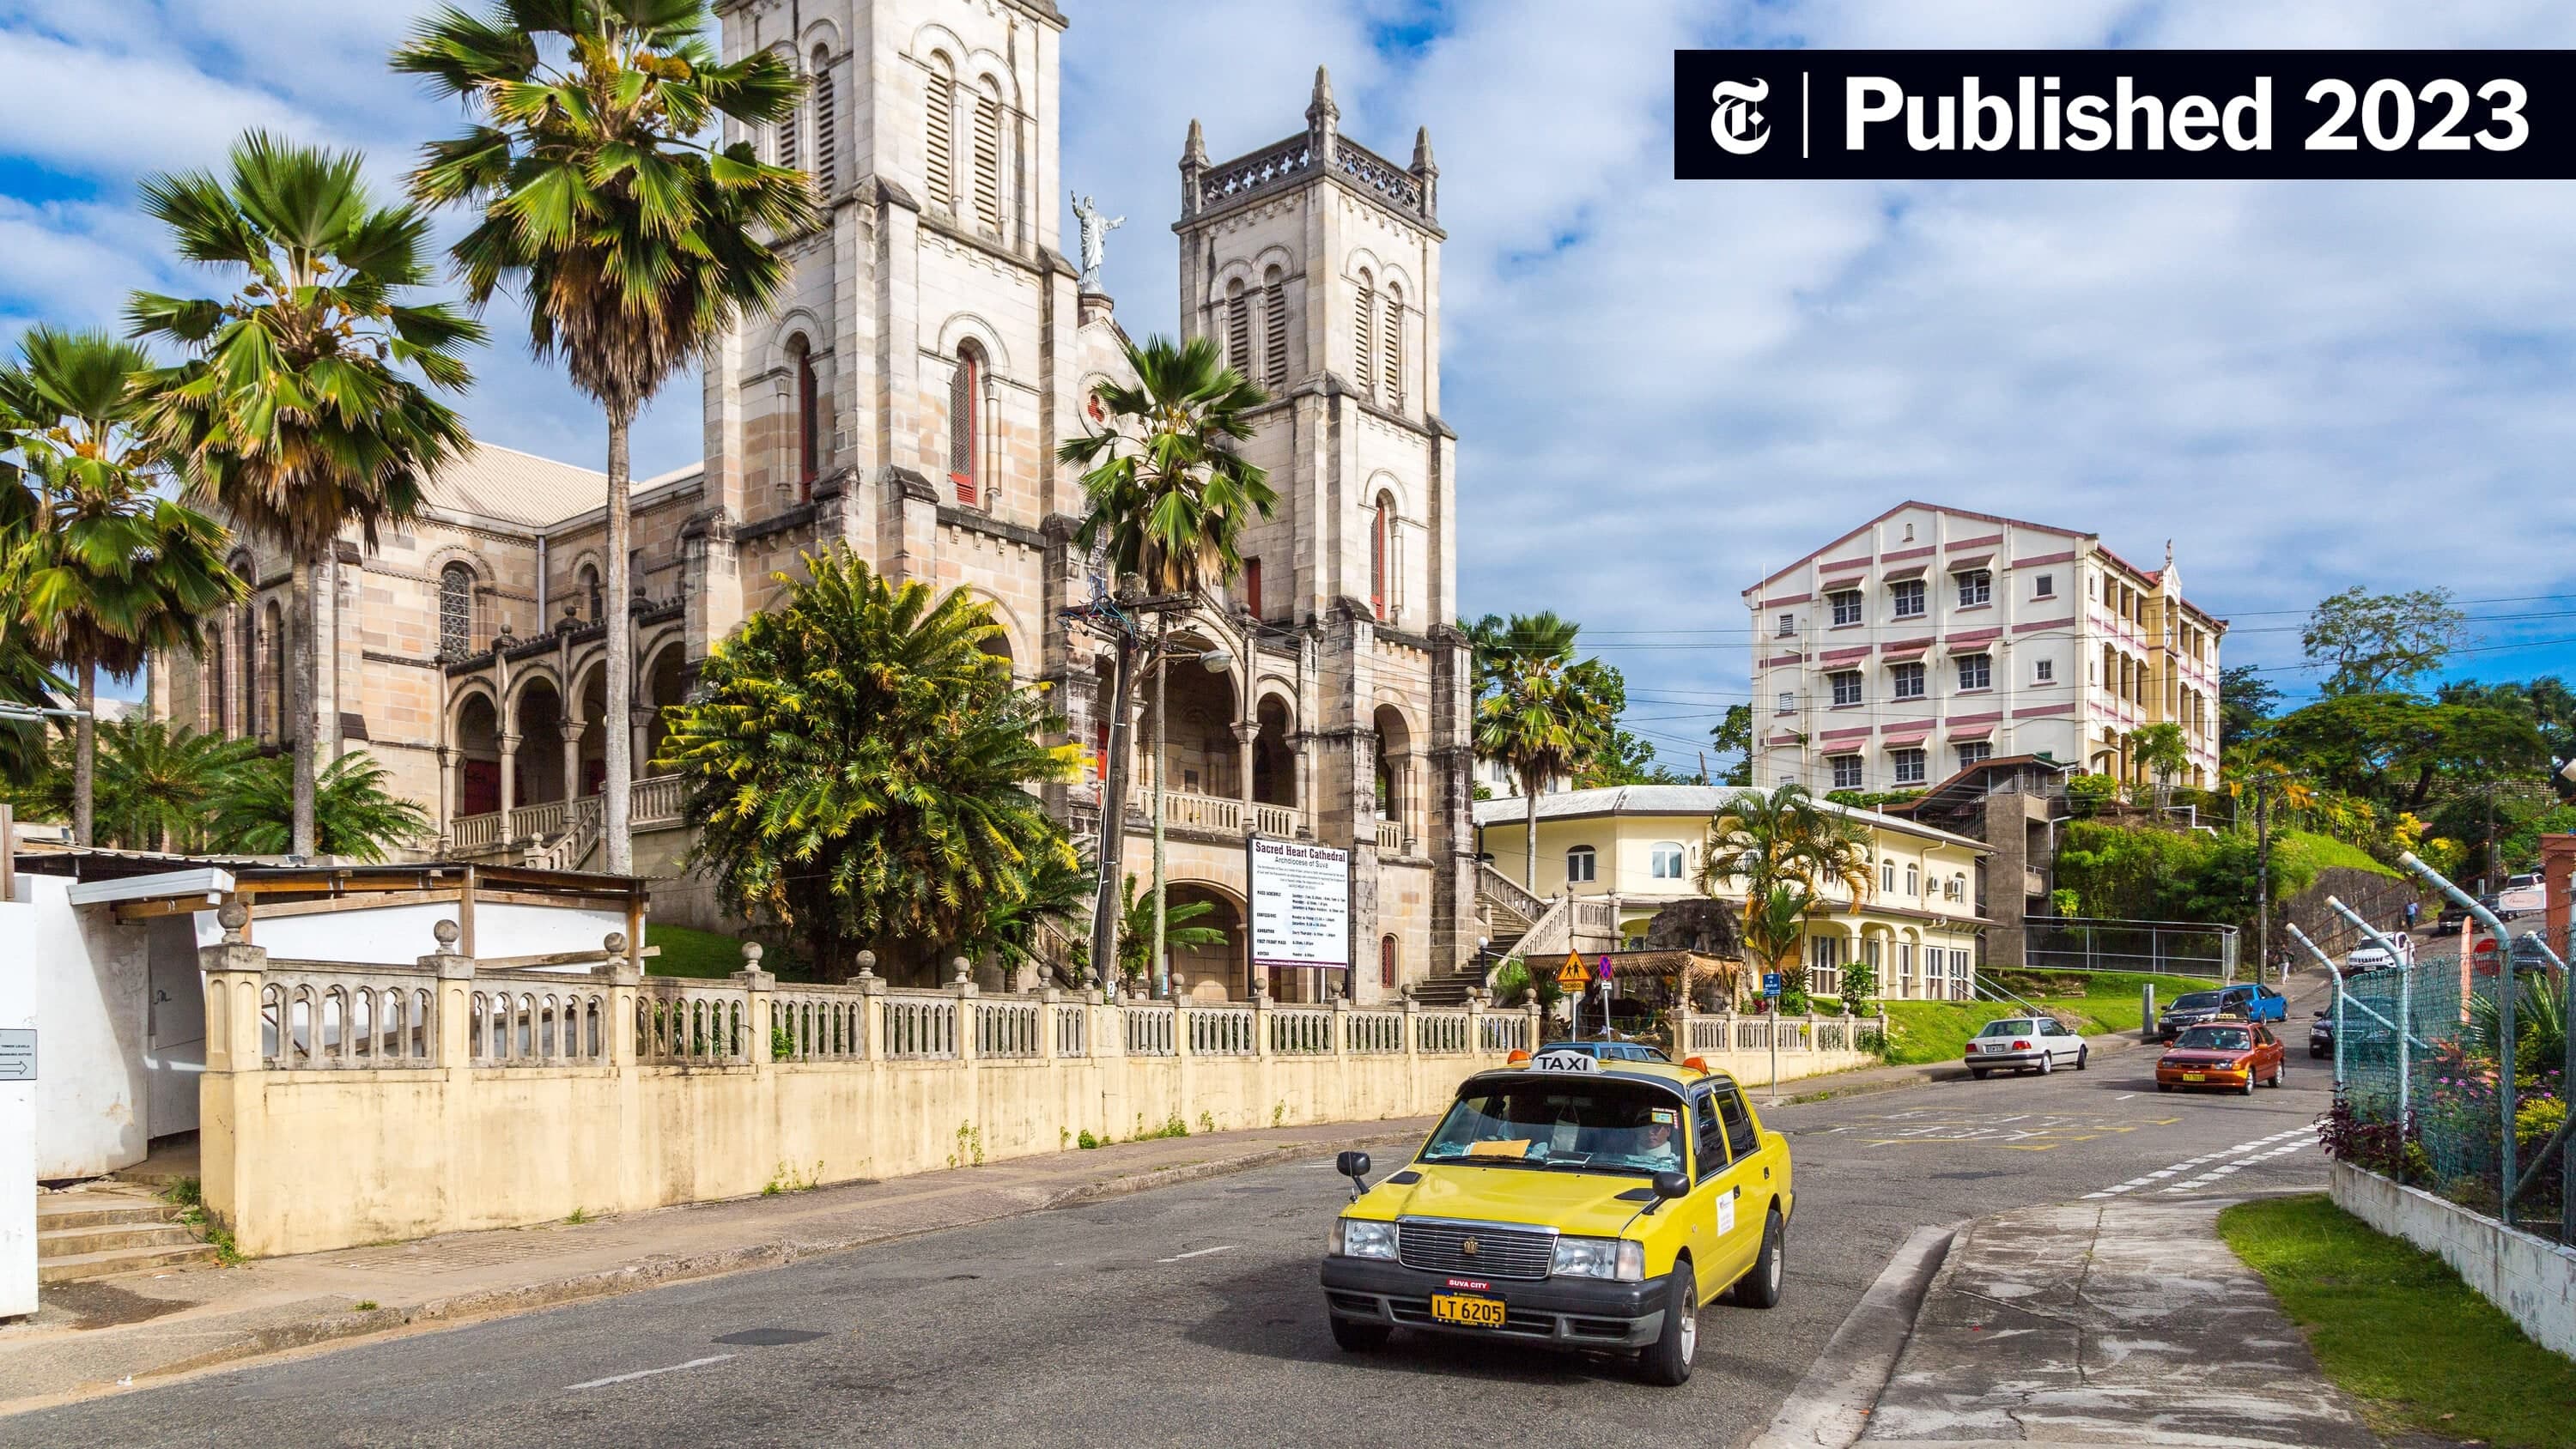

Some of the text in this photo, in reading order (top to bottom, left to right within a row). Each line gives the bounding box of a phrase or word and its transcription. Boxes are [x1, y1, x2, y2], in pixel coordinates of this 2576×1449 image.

[1255, 841, 1346, 862] Sacred Heart Cathedral
[1274, 856, 1308, 866] Archdiocese
[1315, 860, 1328, 869] Suva
[1538, 1057, 1588, 1071] TAXI
[1449, 1279, 1468, 1288] SUVA
[1437, 1300, 1502, 1322] LT 6205
